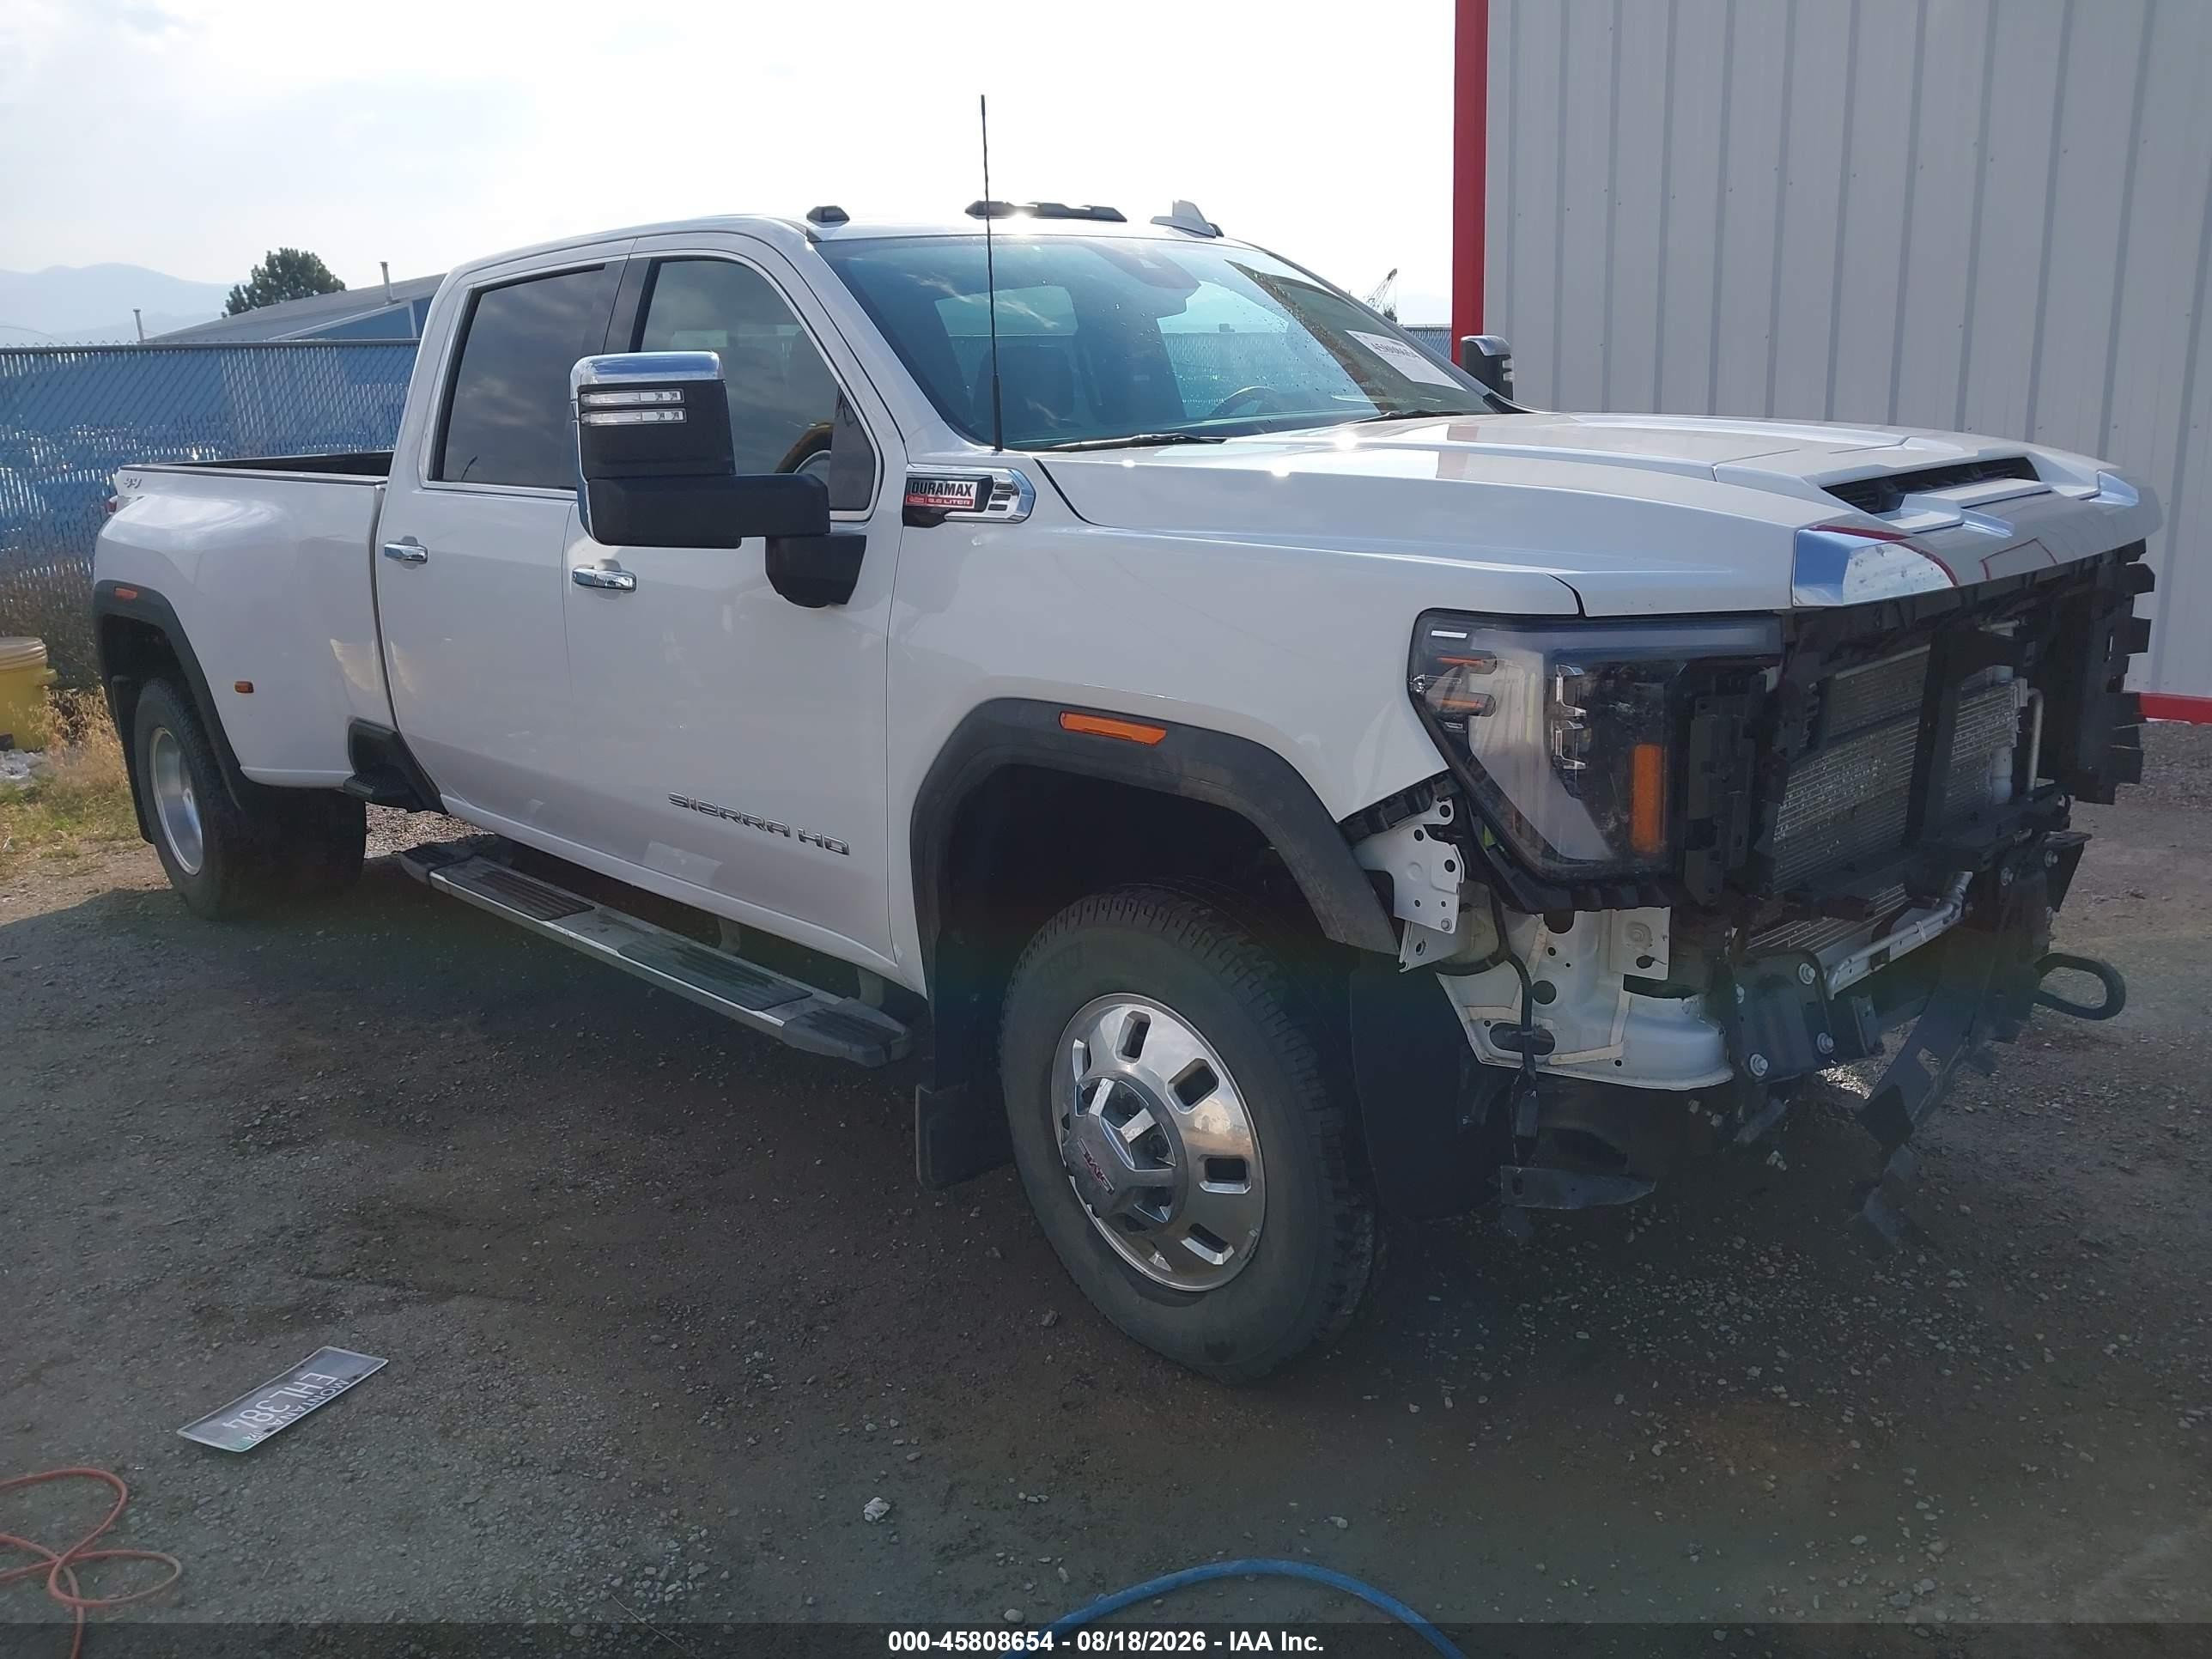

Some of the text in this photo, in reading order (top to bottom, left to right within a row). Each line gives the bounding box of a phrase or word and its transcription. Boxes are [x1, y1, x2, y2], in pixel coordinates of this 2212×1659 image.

[910, 480, 973, 497] DURAMAX
[666, 792, 850, 856] SIERRA HD
[267, 1379, 350, 1426] MONTANA
